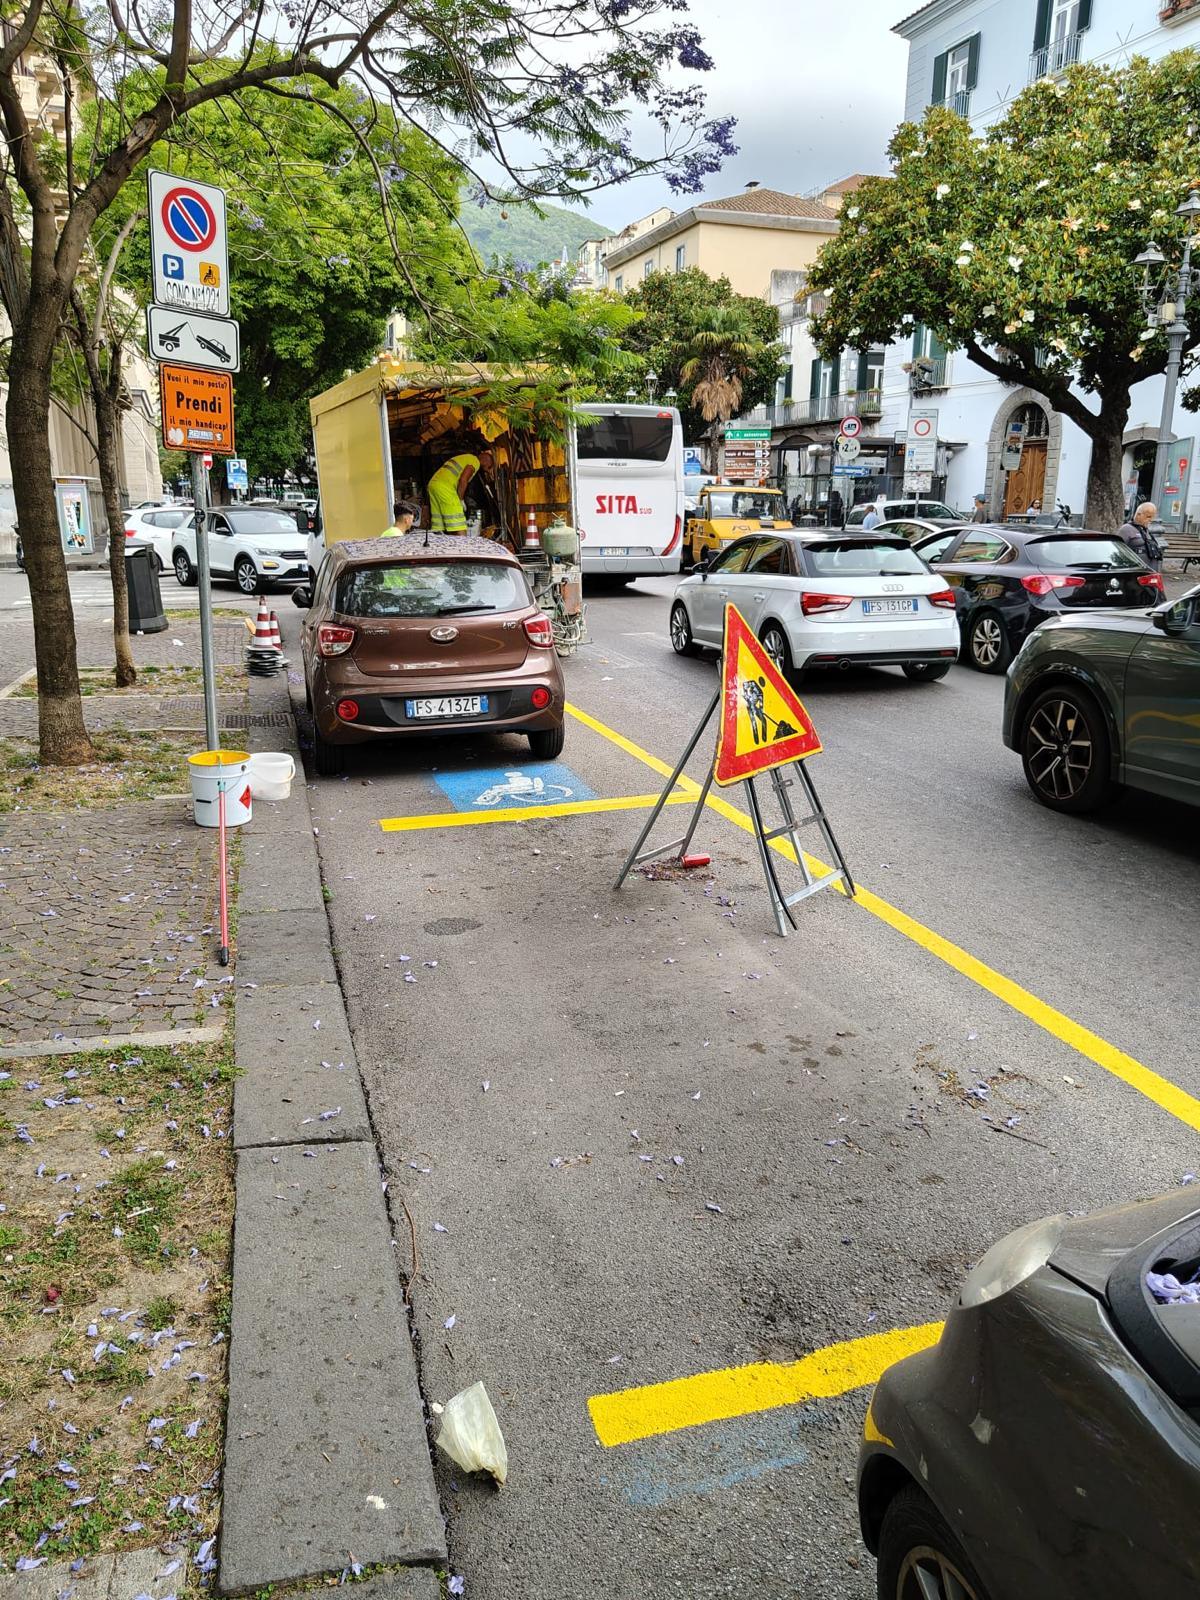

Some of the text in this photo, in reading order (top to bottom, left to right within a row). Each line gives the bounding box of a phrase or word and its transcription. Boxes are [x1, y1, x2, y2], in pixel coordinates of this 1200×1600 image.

[167, 258, 179, 275] P
[184, 376, 190, 384] il
[208, 381, 227, 390] posto?
[176, 391, 222, 414] Prendi
[685, 450, 694, 463] P
[230, 462, 239, 473] P
[596, 495, 638, 514] SITA
[871, 602, 882, 611] FS
[416, 698, 478, 714] FS 413ZF
